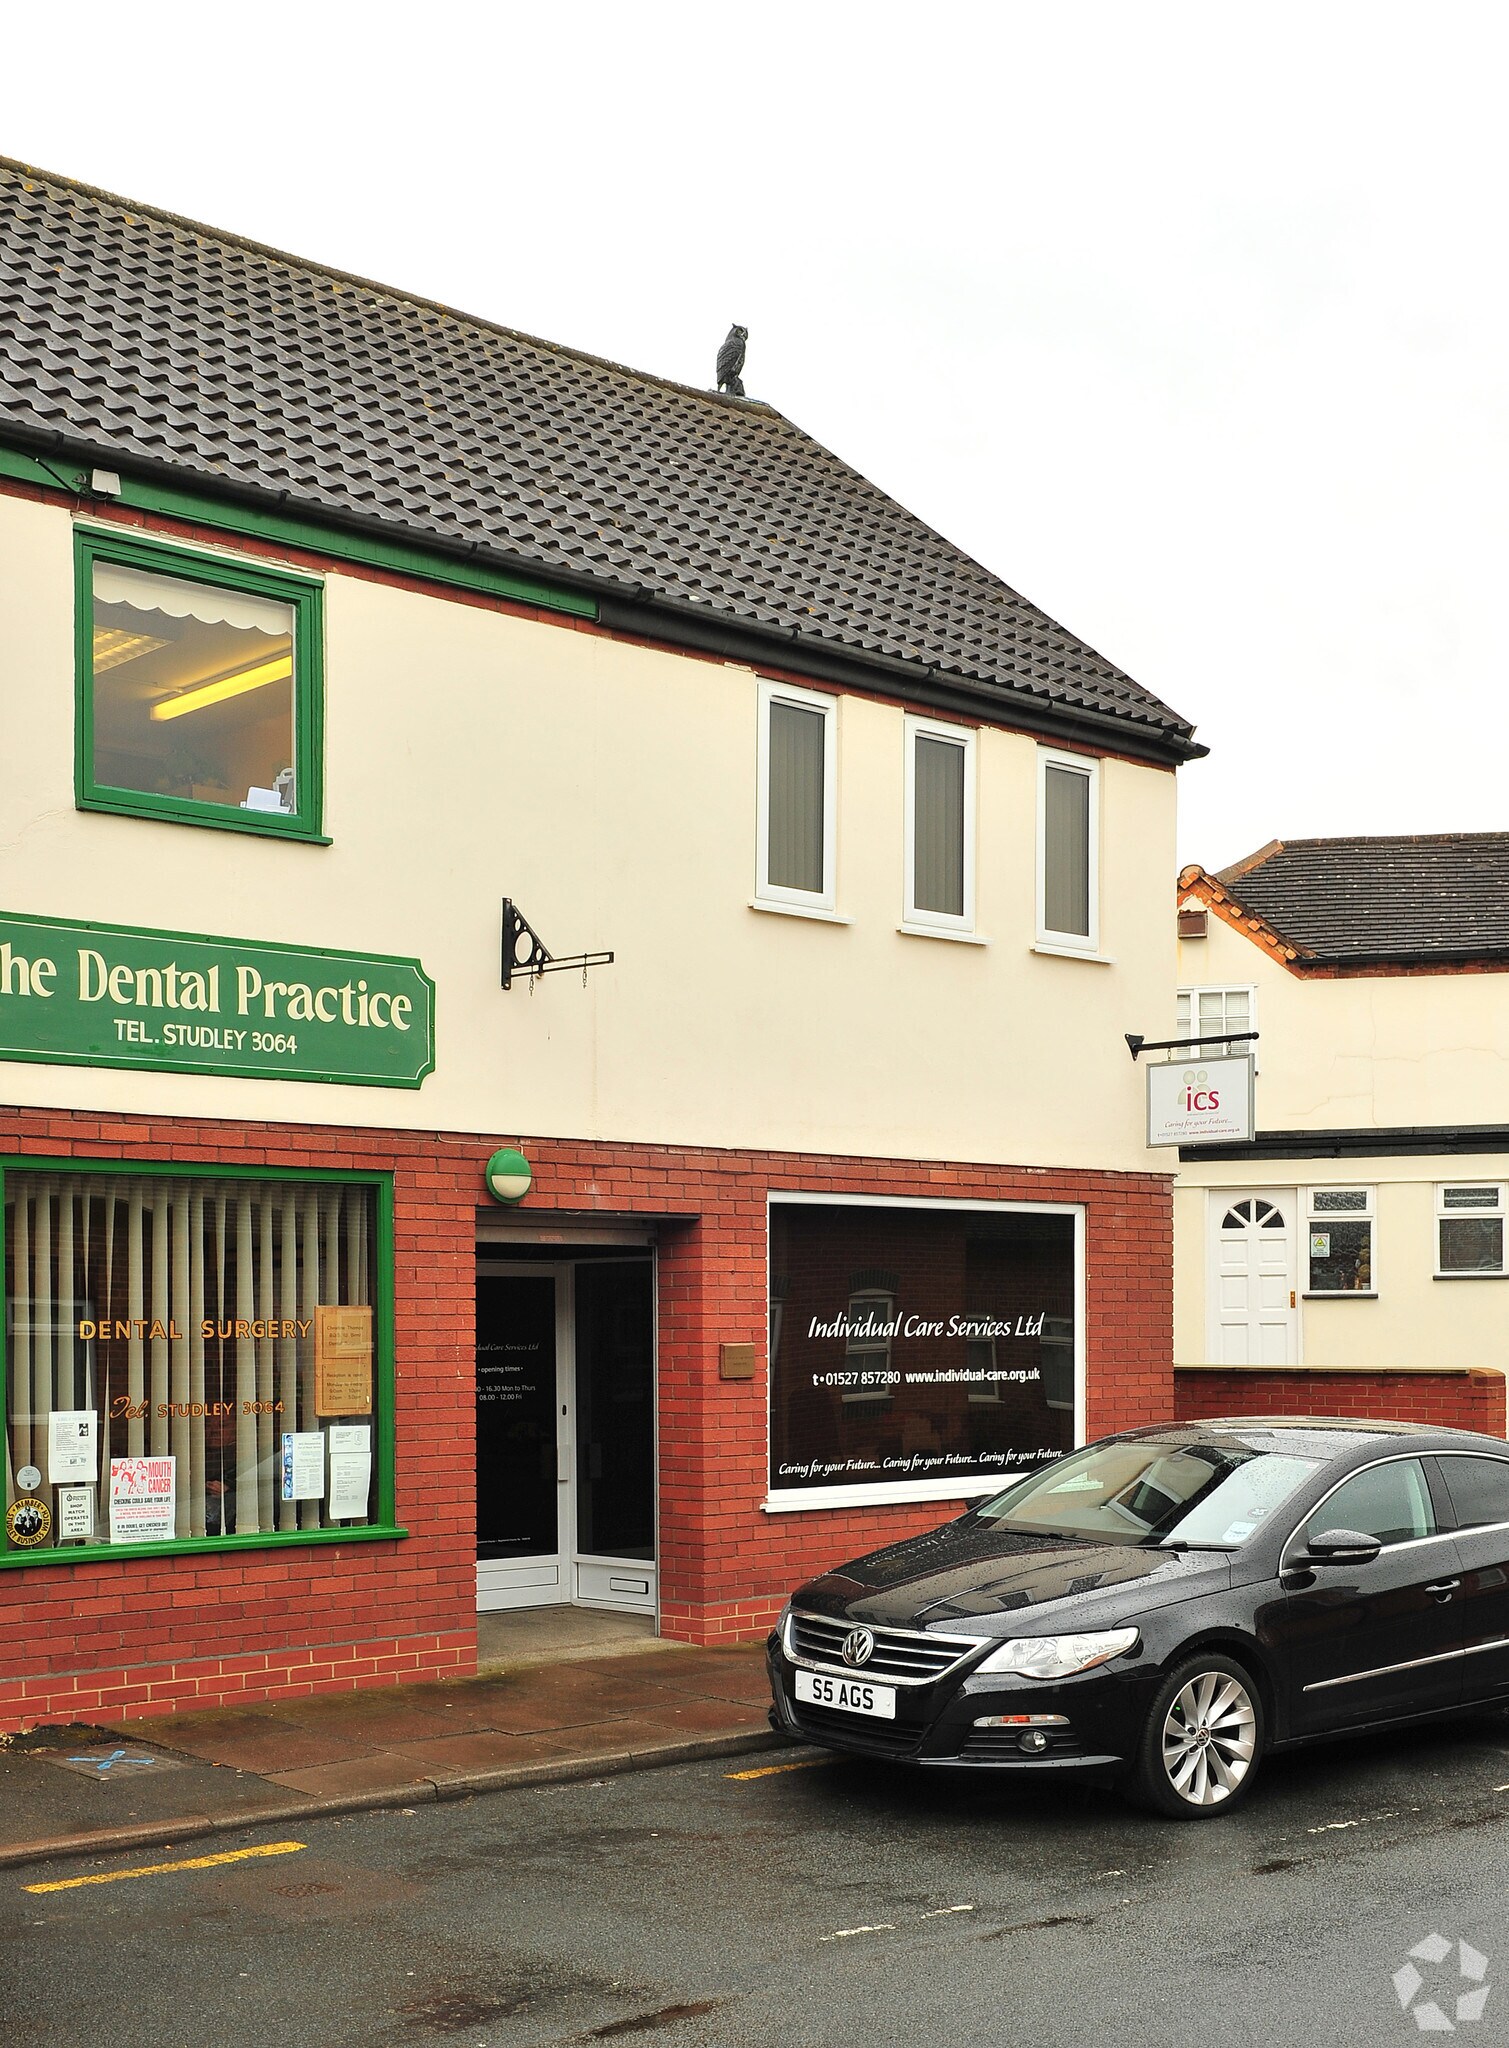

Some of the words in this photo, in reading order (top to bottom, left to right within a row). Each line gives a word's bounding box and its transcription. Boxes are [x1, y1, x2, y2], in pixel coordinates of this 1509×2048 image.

[77, 949, 221, 1013] Dental
[235, 966, 413, 1031] Practice
[113, 1019, 160, 1043] TEL.
[164, 1023, 247, 1051] STUDLEY
[252, 1032, 298, 1055] 3064
[1164, 1120, 1184, 1129] Caring
[1184, 1119, 1193, 1128] for
[79, 1319, 183, 1340] DENTAL
[200, 1319, 314, 1339] SURGERY
[808, 1311, 904, 1338] Individual
[903, 1315, 944, 1338] Care
[946, 1315, 1012, 1337] Services
[1014, 1311, 1045, 1336] Ltd
[504, 1343, 527, 1351] Services
[480, 1366, 504, 1374] opening
[860, 1370, 901, 1385] 857280
[905, 1366, 1041, 1384] www.individual-care.org.uk
[109, 1396, 149, 1420] Tel.
[157, 1402, 234, 1418] STUDLEY
[242, 1400, 285, 1415] 3064
[148, 1461, 172, 1478] MOUTH
[779, 1462, 808, 1478] Caring
[808, 1459, 822, 1478] for
[822, 1463, 845, 1477] your
[882, 1457, 911, 1472] Caring
[910, 1453, 924, 1472] for
[923, 1457, 945, 1471] your
[979, 1451, 1004, 1466] Caring
[1004, 1448, 1018, 1466] for
[1016, 1451, 1036, 1465] your
[148, 1478, 171, 1493] CANCER
[15, 1499, 42, 1510] MEMBER
[812, 1678, 834, 1702] S5
[838, 1683, 874, 1710] AGS
